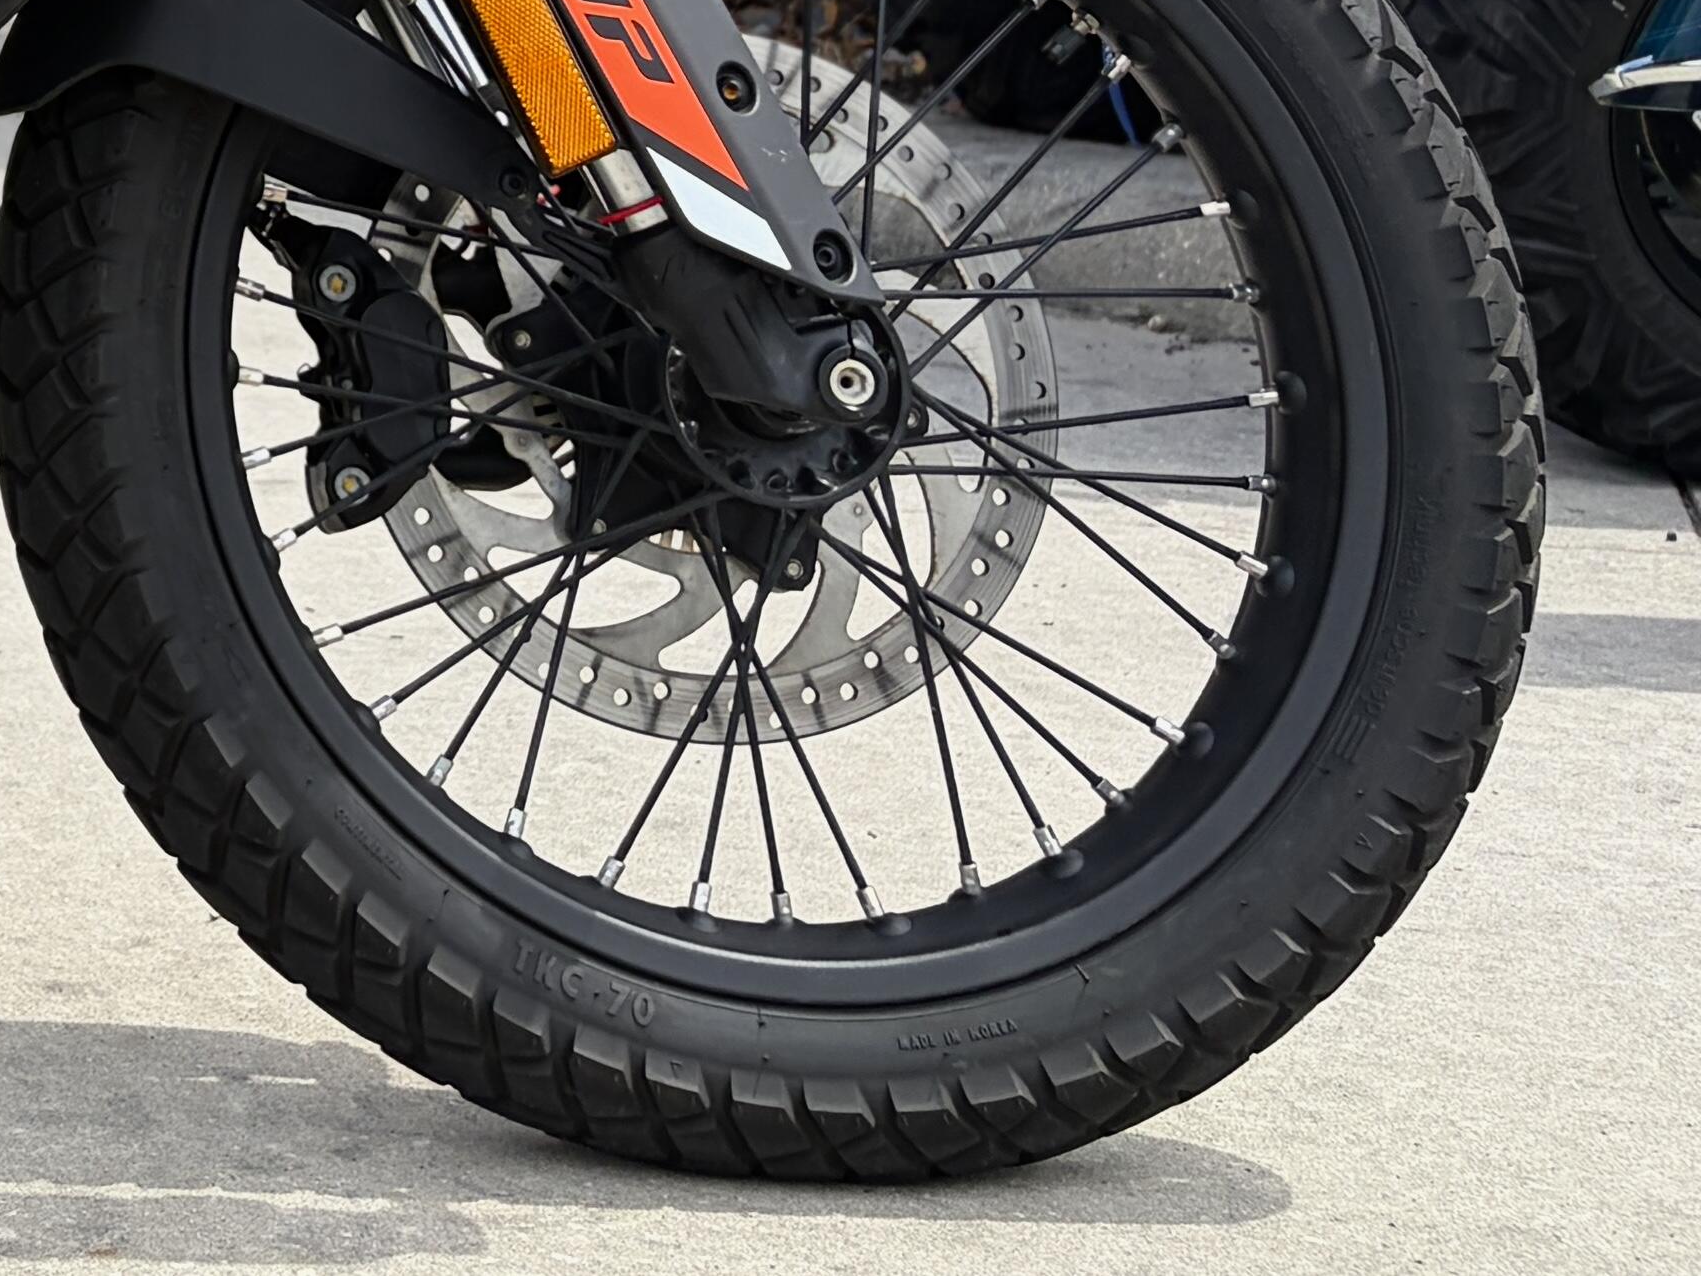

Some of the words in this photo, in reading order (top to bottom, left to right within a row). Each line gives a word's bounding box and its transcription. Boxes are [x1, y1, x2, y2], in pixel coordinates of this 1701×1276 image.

[513, 938, 584, 1000] TKC
[607, 982, 655, 1027] 70
[943, 1028, 962, 1047] IN
